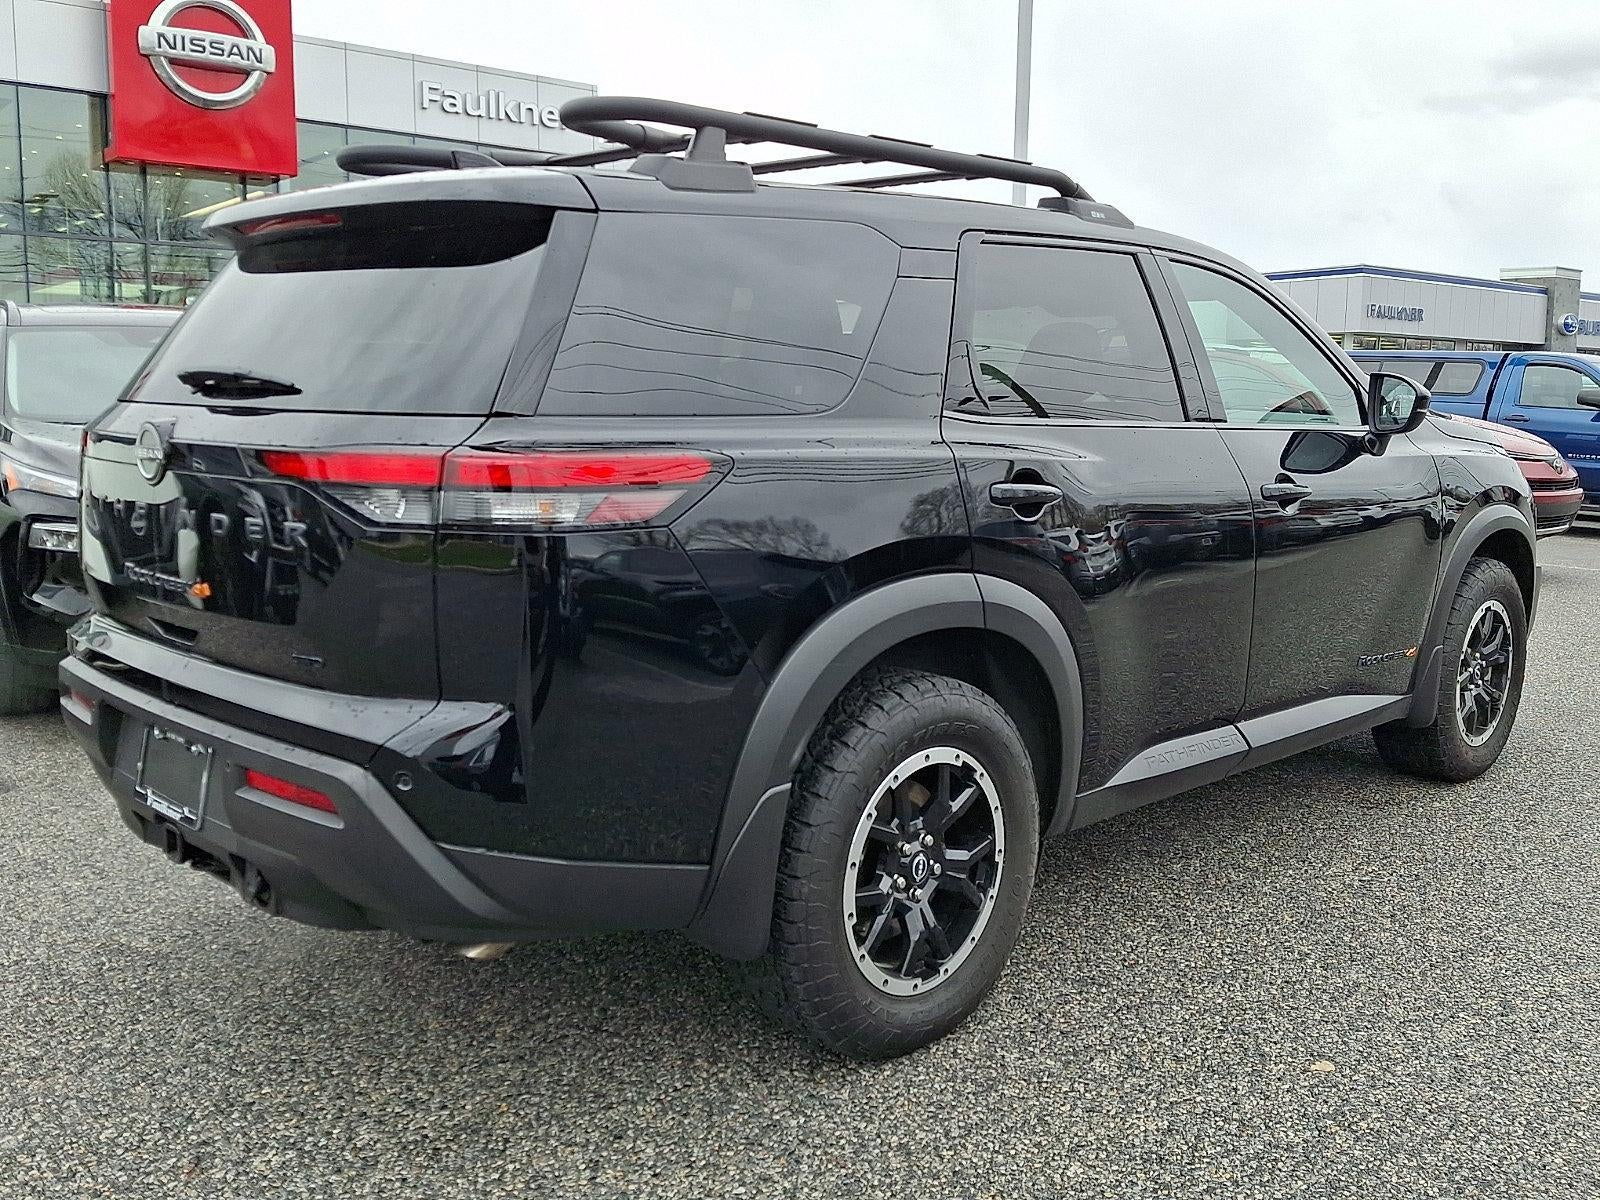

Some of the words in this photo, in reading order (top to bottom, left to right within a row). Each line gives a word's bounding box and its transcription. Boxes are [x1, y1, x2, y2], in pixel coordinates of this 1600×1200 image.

[156, 31, 263, 65] NISSAN
[421, 80, 564, 130] Faulkne
[1144, 733, 1241, 769] PATHFINDER
